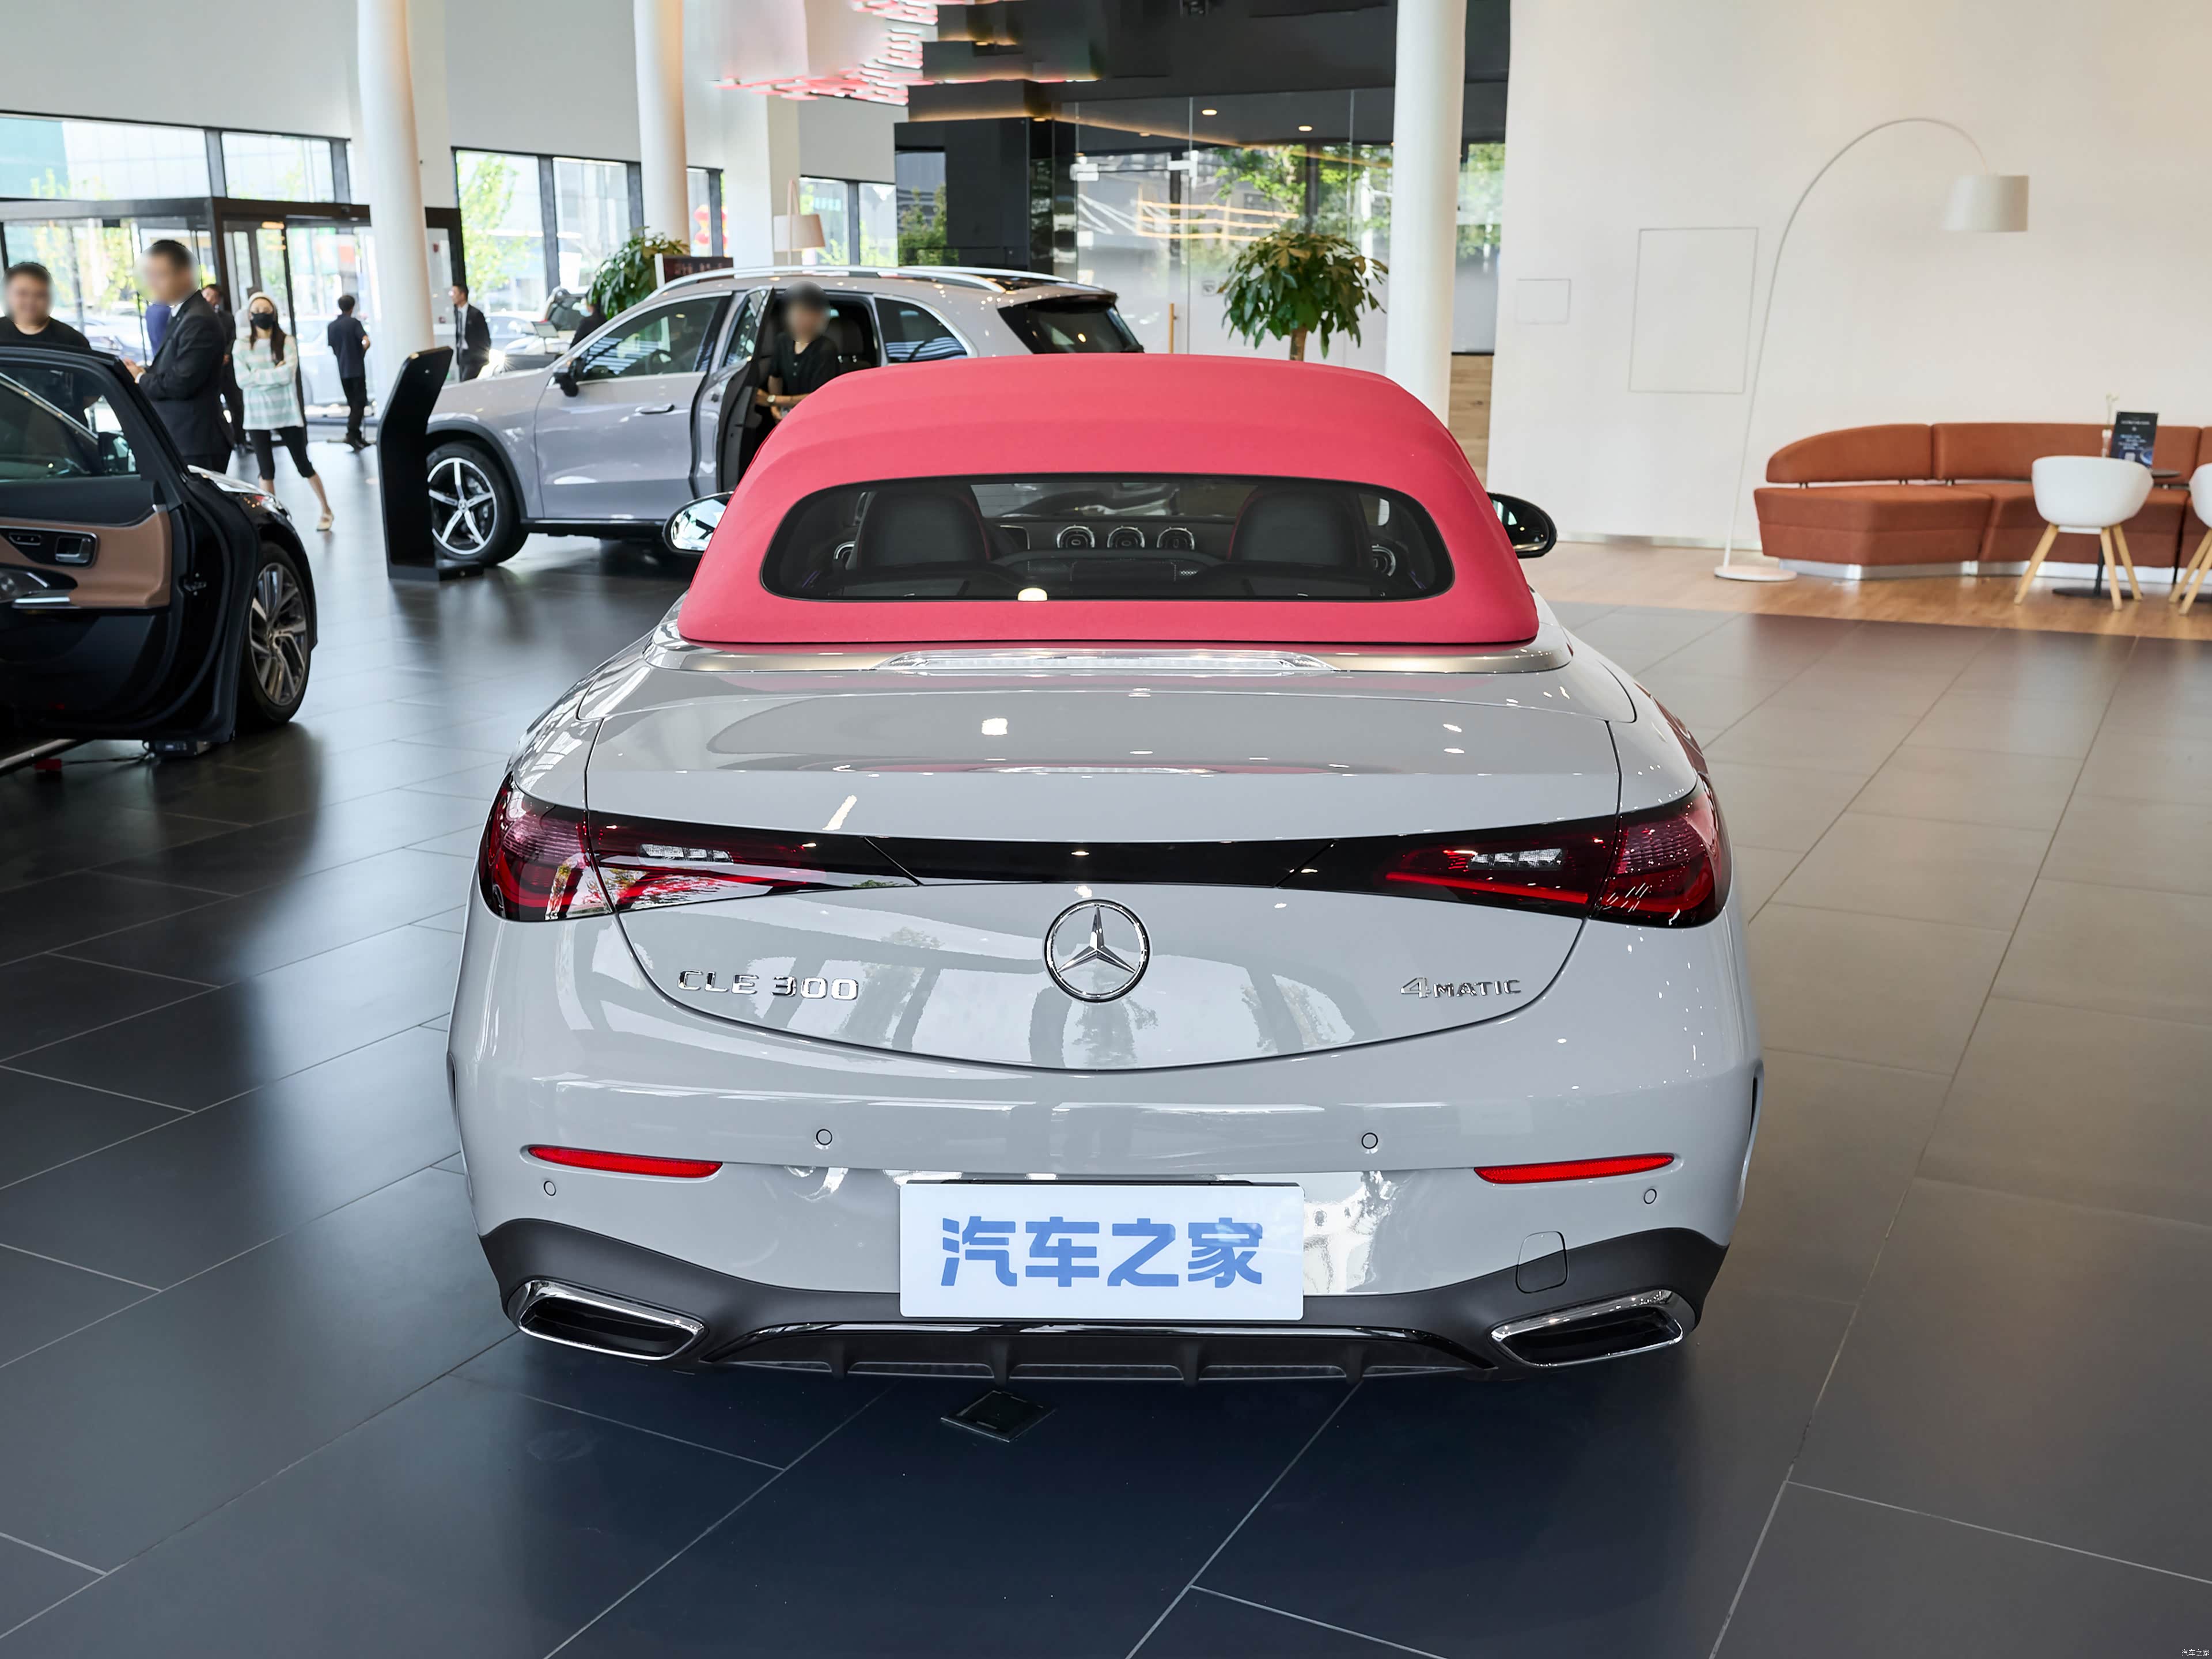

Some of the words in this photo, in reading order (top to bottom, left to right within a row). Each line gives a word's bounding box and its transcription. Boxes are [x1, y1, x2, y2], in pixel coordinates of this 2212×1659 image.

[678, 969, 759, 995] CLE
[771, 976, 859, 1000] 300
[1400, 977, 1521, 998] 4MATIC
[941, 1215, 1263, 1288] 汽车之家
